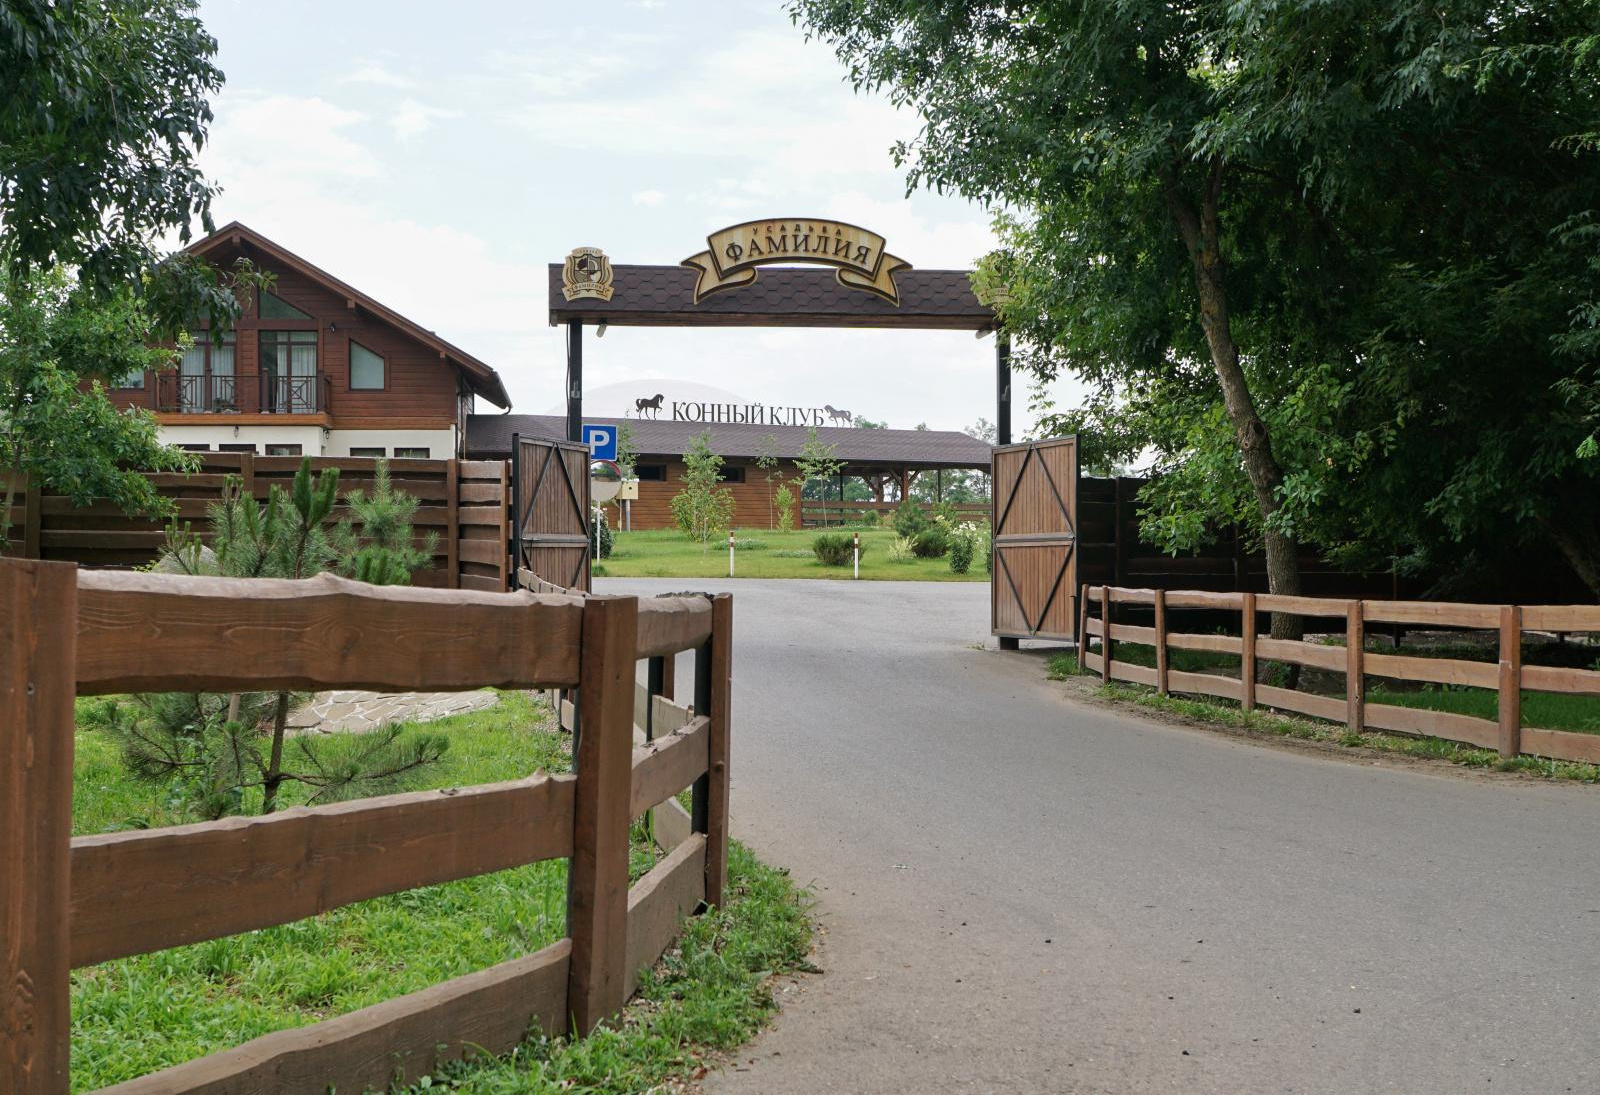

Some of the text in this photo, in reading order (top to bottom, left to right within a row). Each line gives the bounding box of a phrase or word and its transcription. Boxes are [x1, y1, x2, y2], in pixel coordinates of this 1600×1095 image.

[753, 224, 842, 236] УСАДЬБА
[725, 234, 871, 265] ФАМИЛИЯ
[672, 401, 825, 427] КОННЫЙ КЛУБ
[589, 429, 610, 456] P
